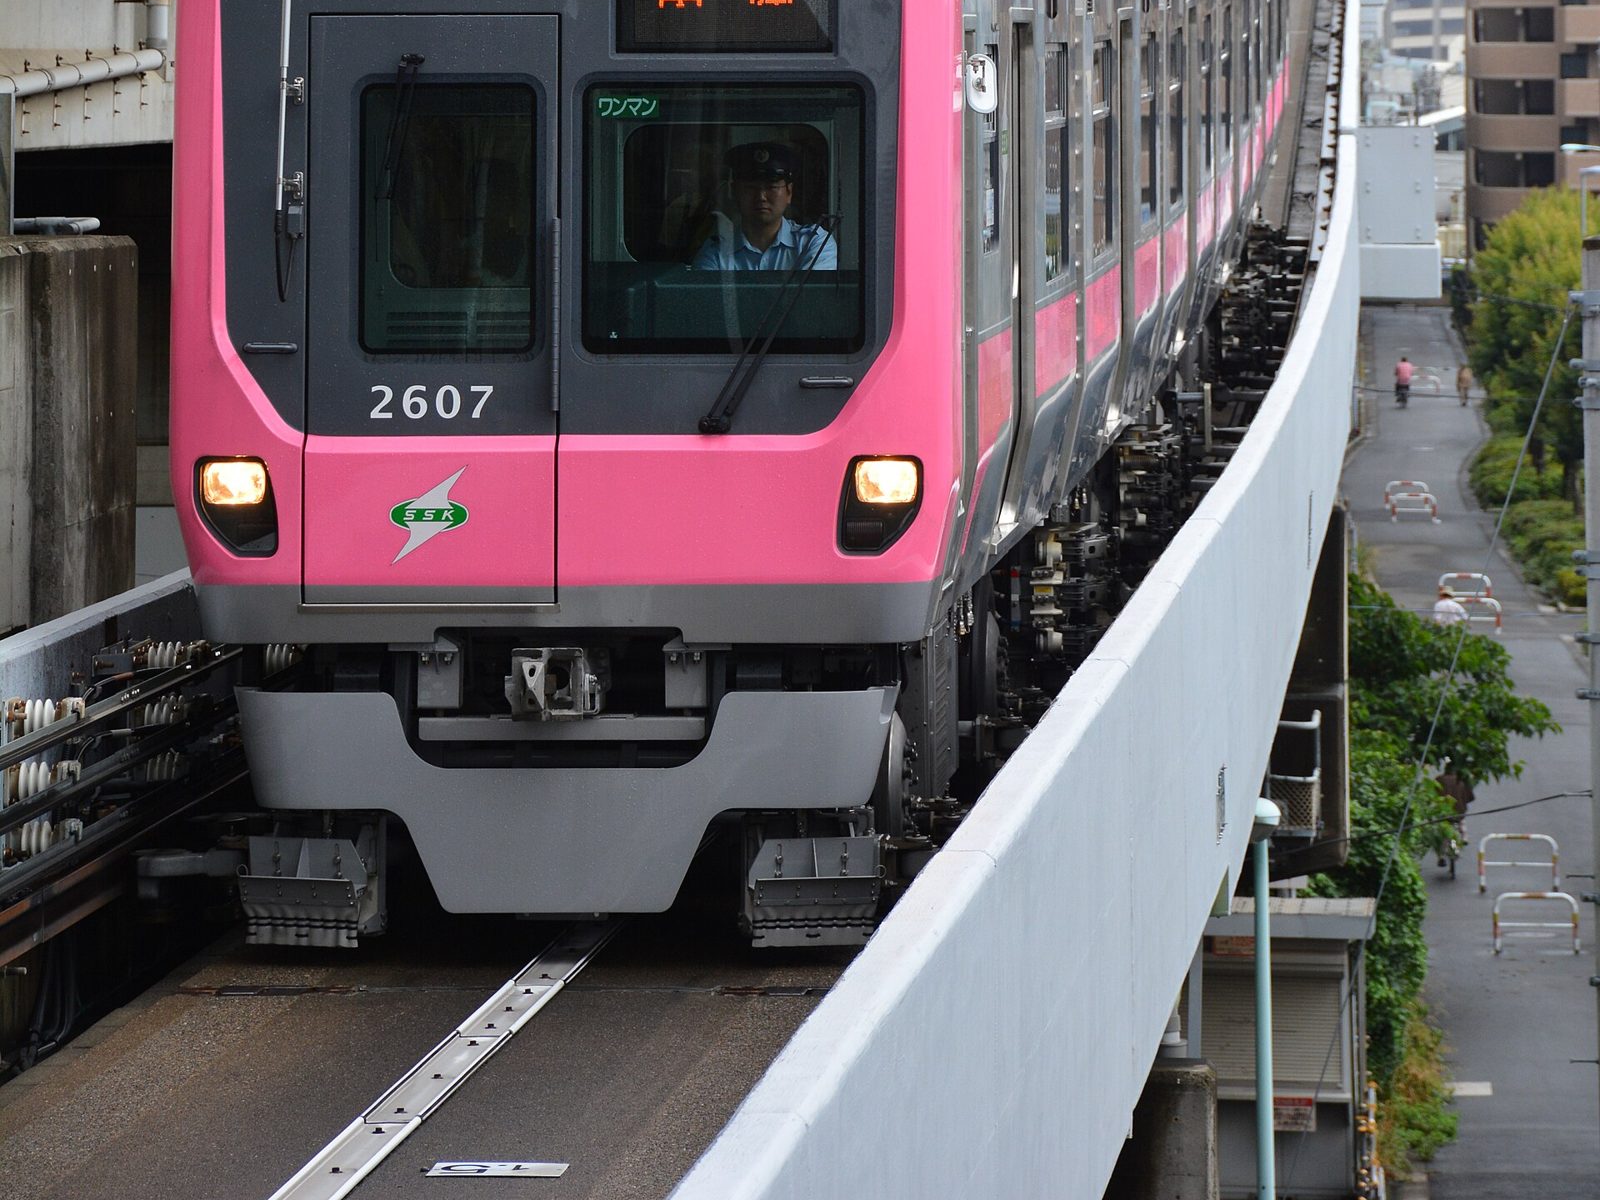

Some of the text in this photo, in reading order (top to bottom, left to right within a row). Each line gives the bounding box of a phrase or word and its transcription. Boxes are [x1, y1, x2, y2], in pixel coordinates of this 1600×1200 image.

[598, 97, 657, 117] ワンマン
[369, 384, 494, 420] 2607
[403, 509, 455, 521] SSK
